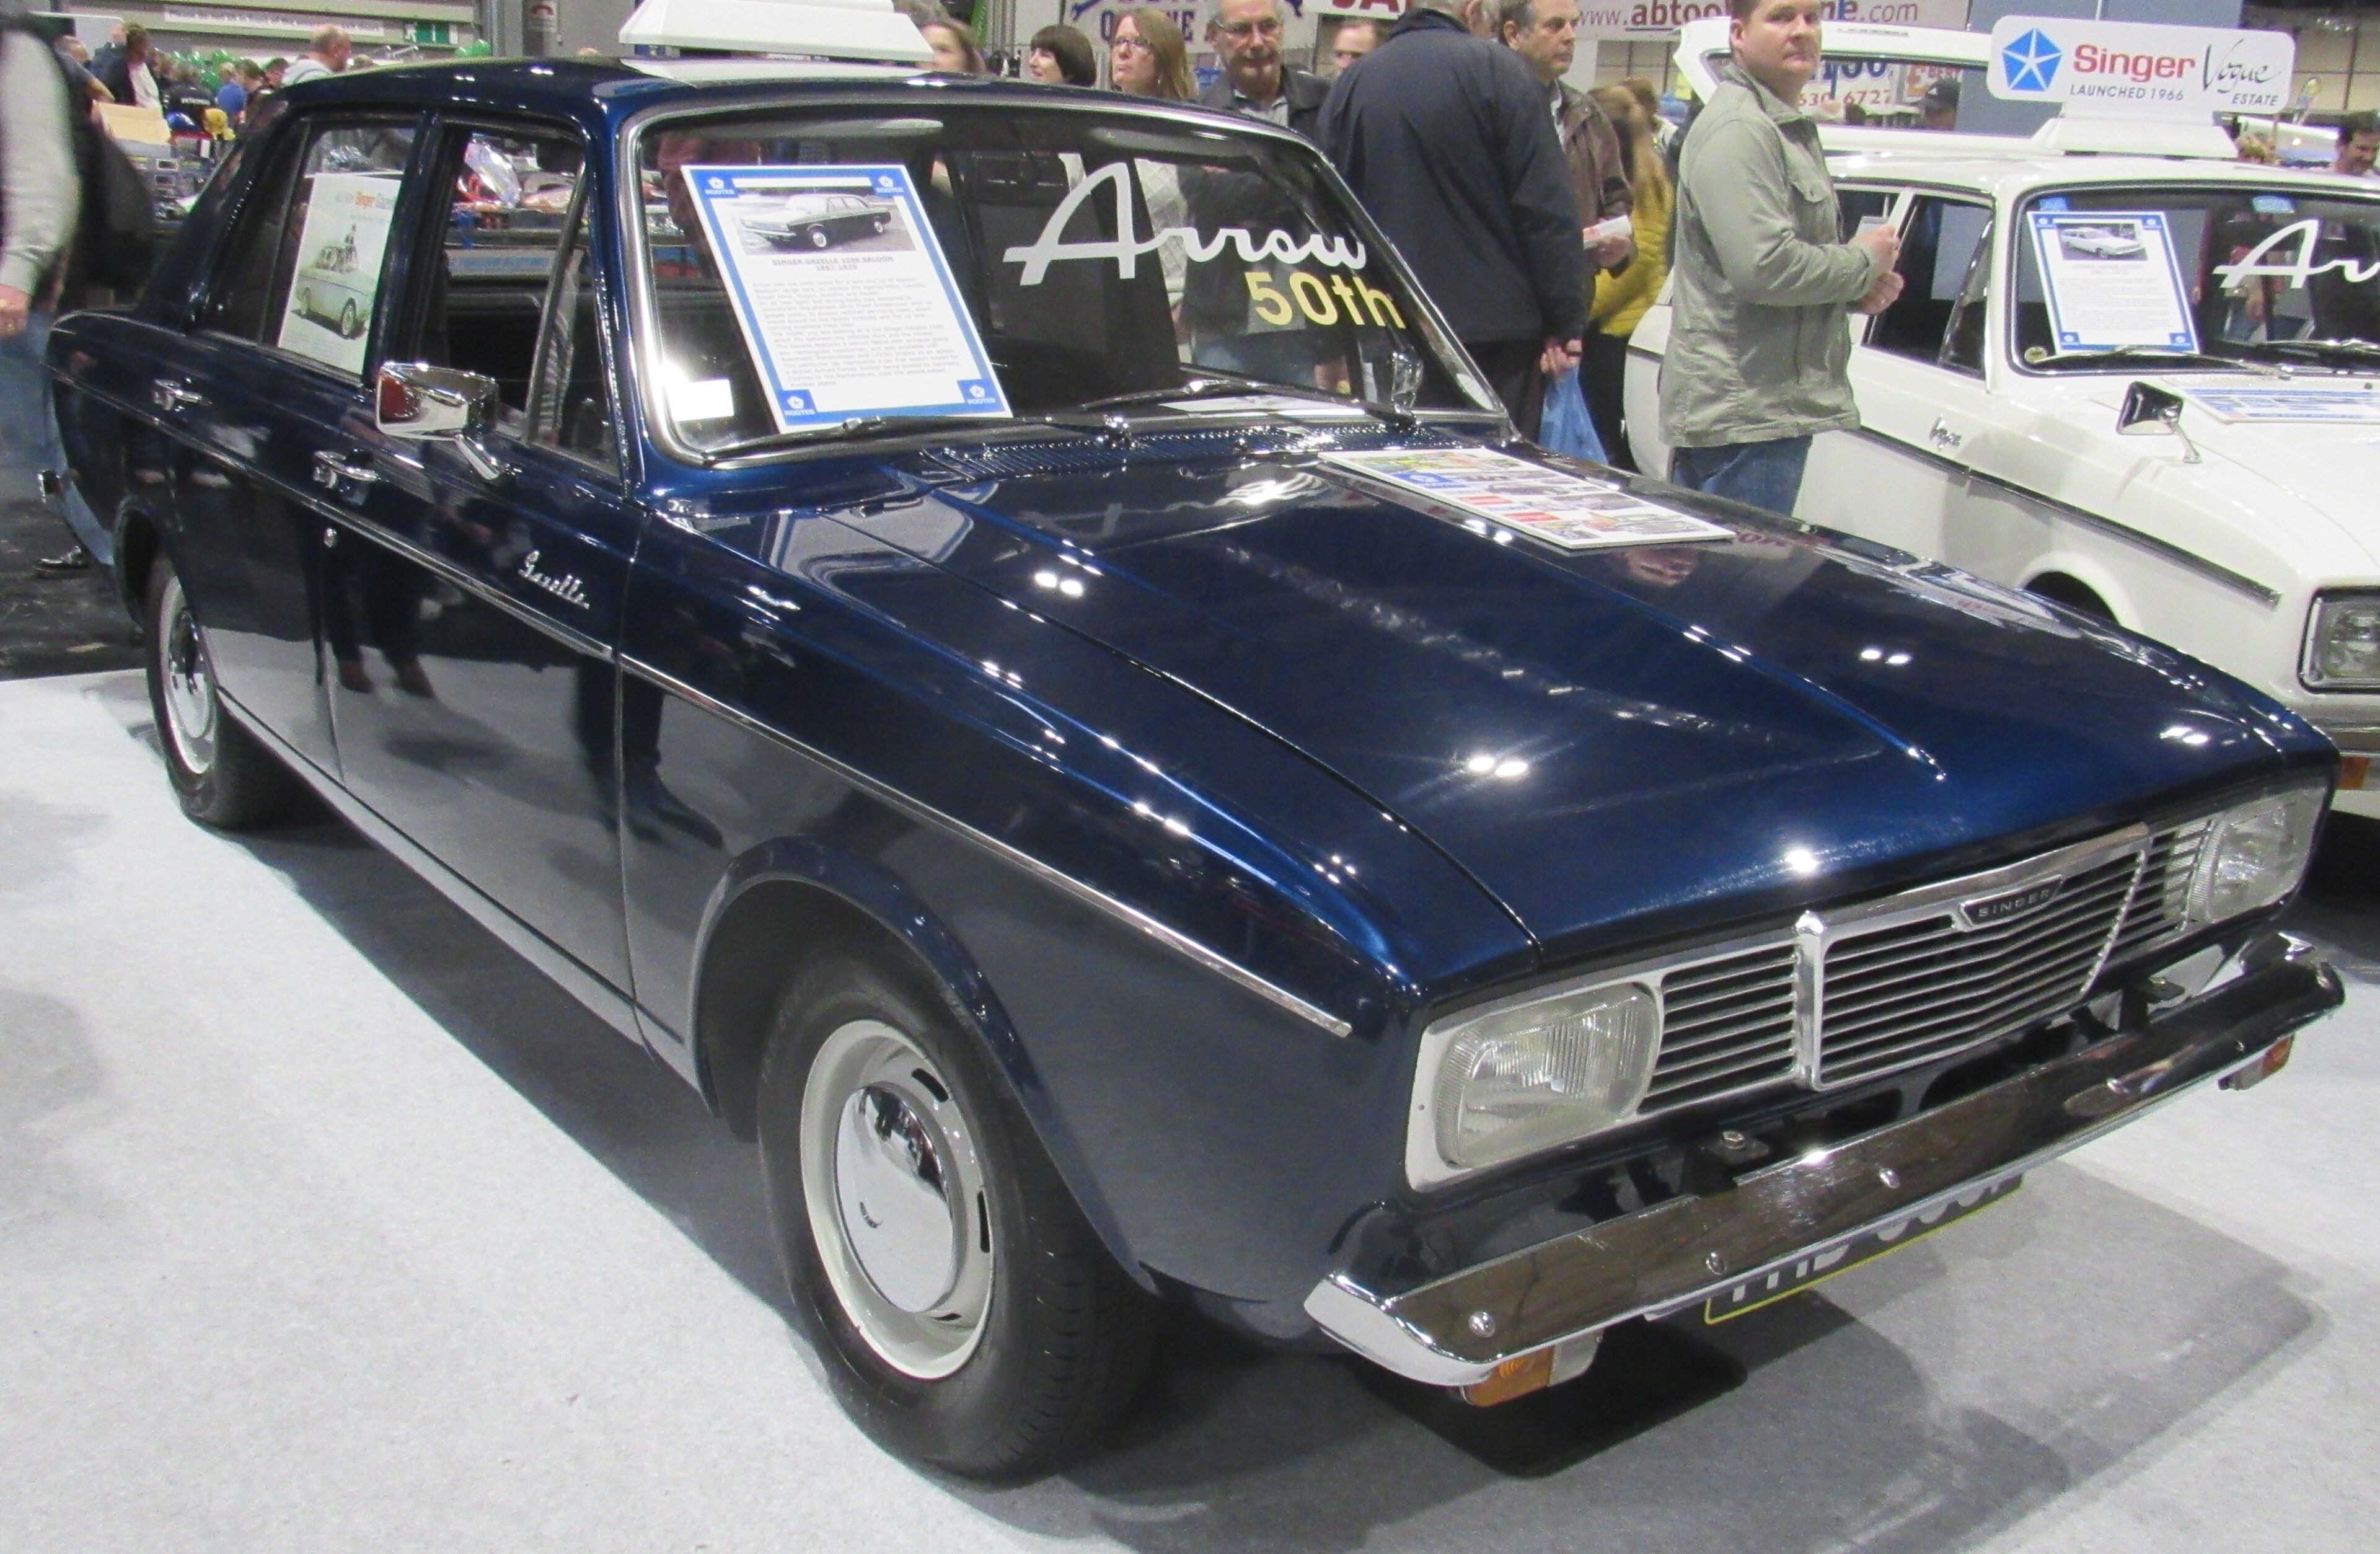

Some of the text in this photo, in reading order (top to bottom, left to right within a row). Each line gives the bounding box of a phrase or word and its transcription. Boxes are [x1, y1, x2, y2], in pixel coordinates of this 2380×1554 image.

[2073, 38, 2281, 94] Singer Vogue
[2070, 84, 2184, 101] LAUNCHED 1966
[2231, 93, 2280, 107] ESTATE
[1003, 162, 1366, 286] Arrow
[1244, 272, 1406, 329] 50th
[1978, 888, 2053, 917] SINGER
